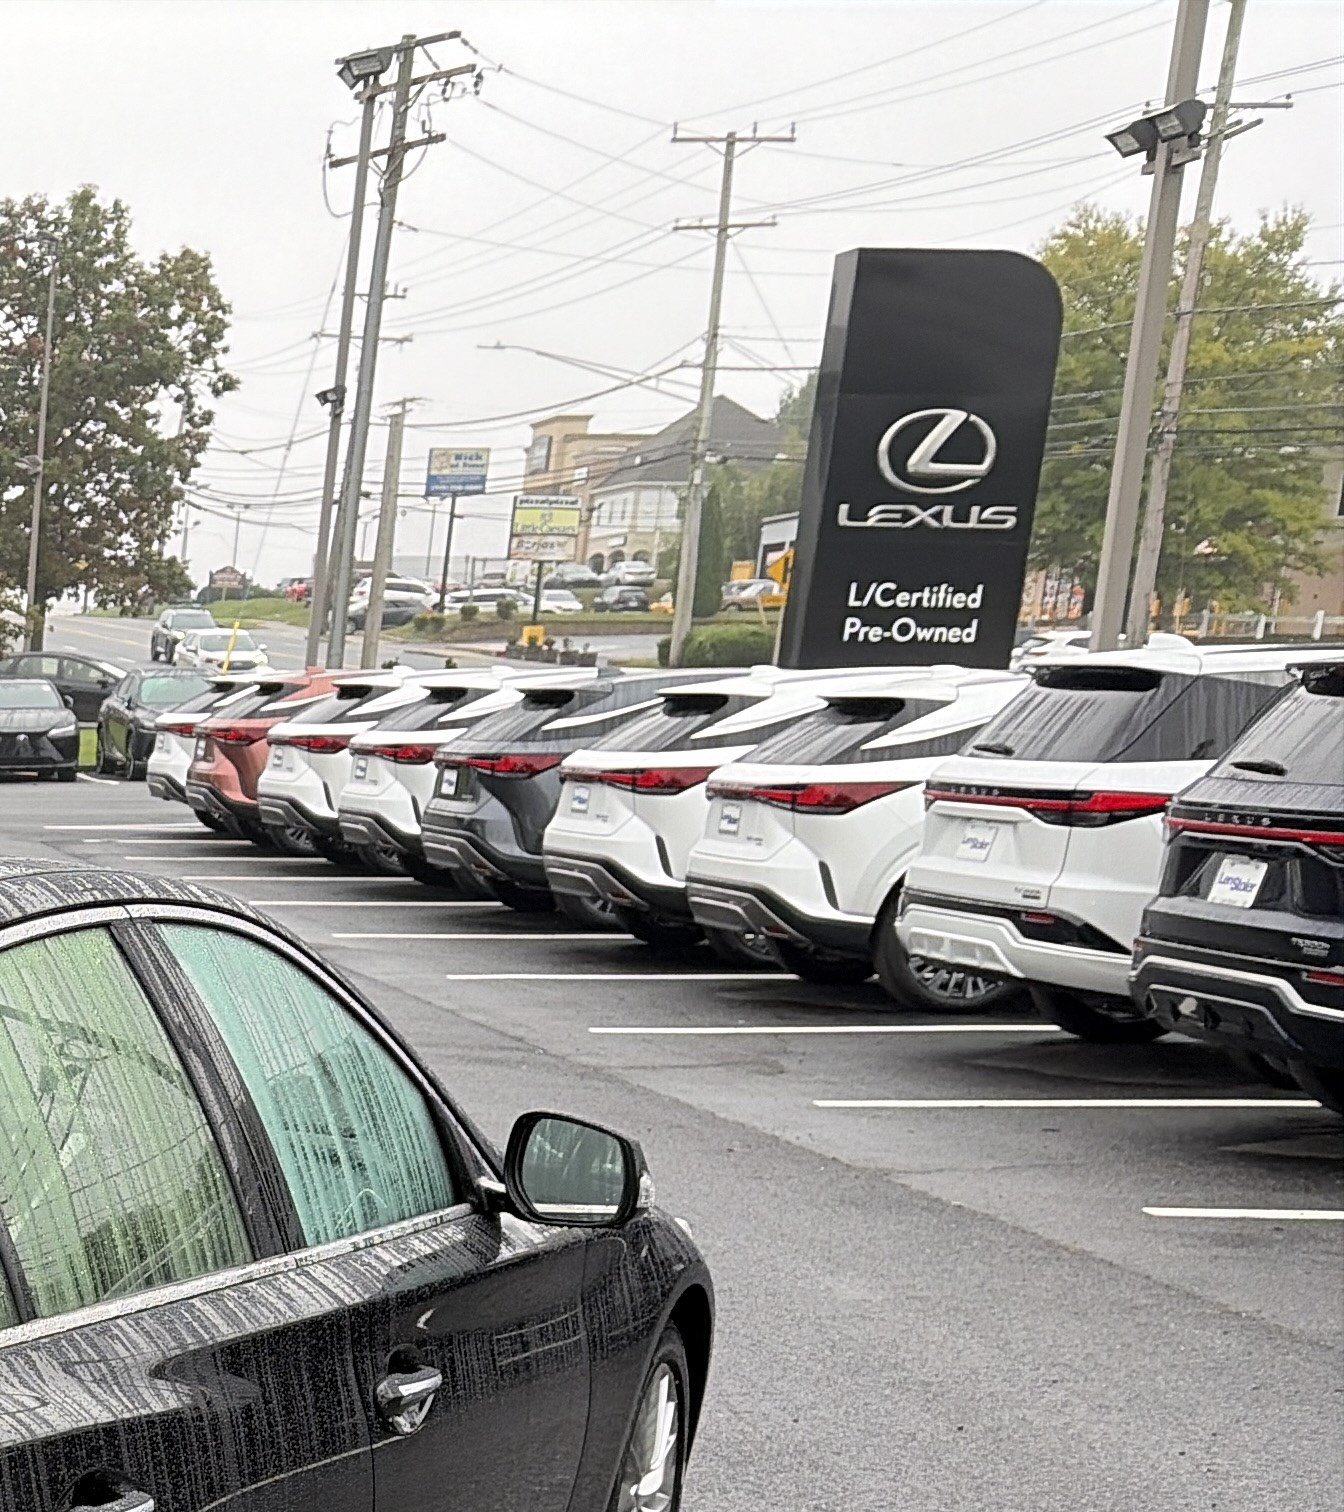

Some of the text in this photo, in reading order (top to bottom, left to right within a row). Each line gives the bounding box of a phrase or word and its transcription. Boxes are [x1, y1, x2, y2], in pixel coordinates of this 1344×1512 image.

[837, 503, 1018, 529] LEXUS
[847, 582, 984, 609] L/Certified
[842, 616, 978, 643] Pre-Owned
[1205, 813, 1271, 826] LEXUS
